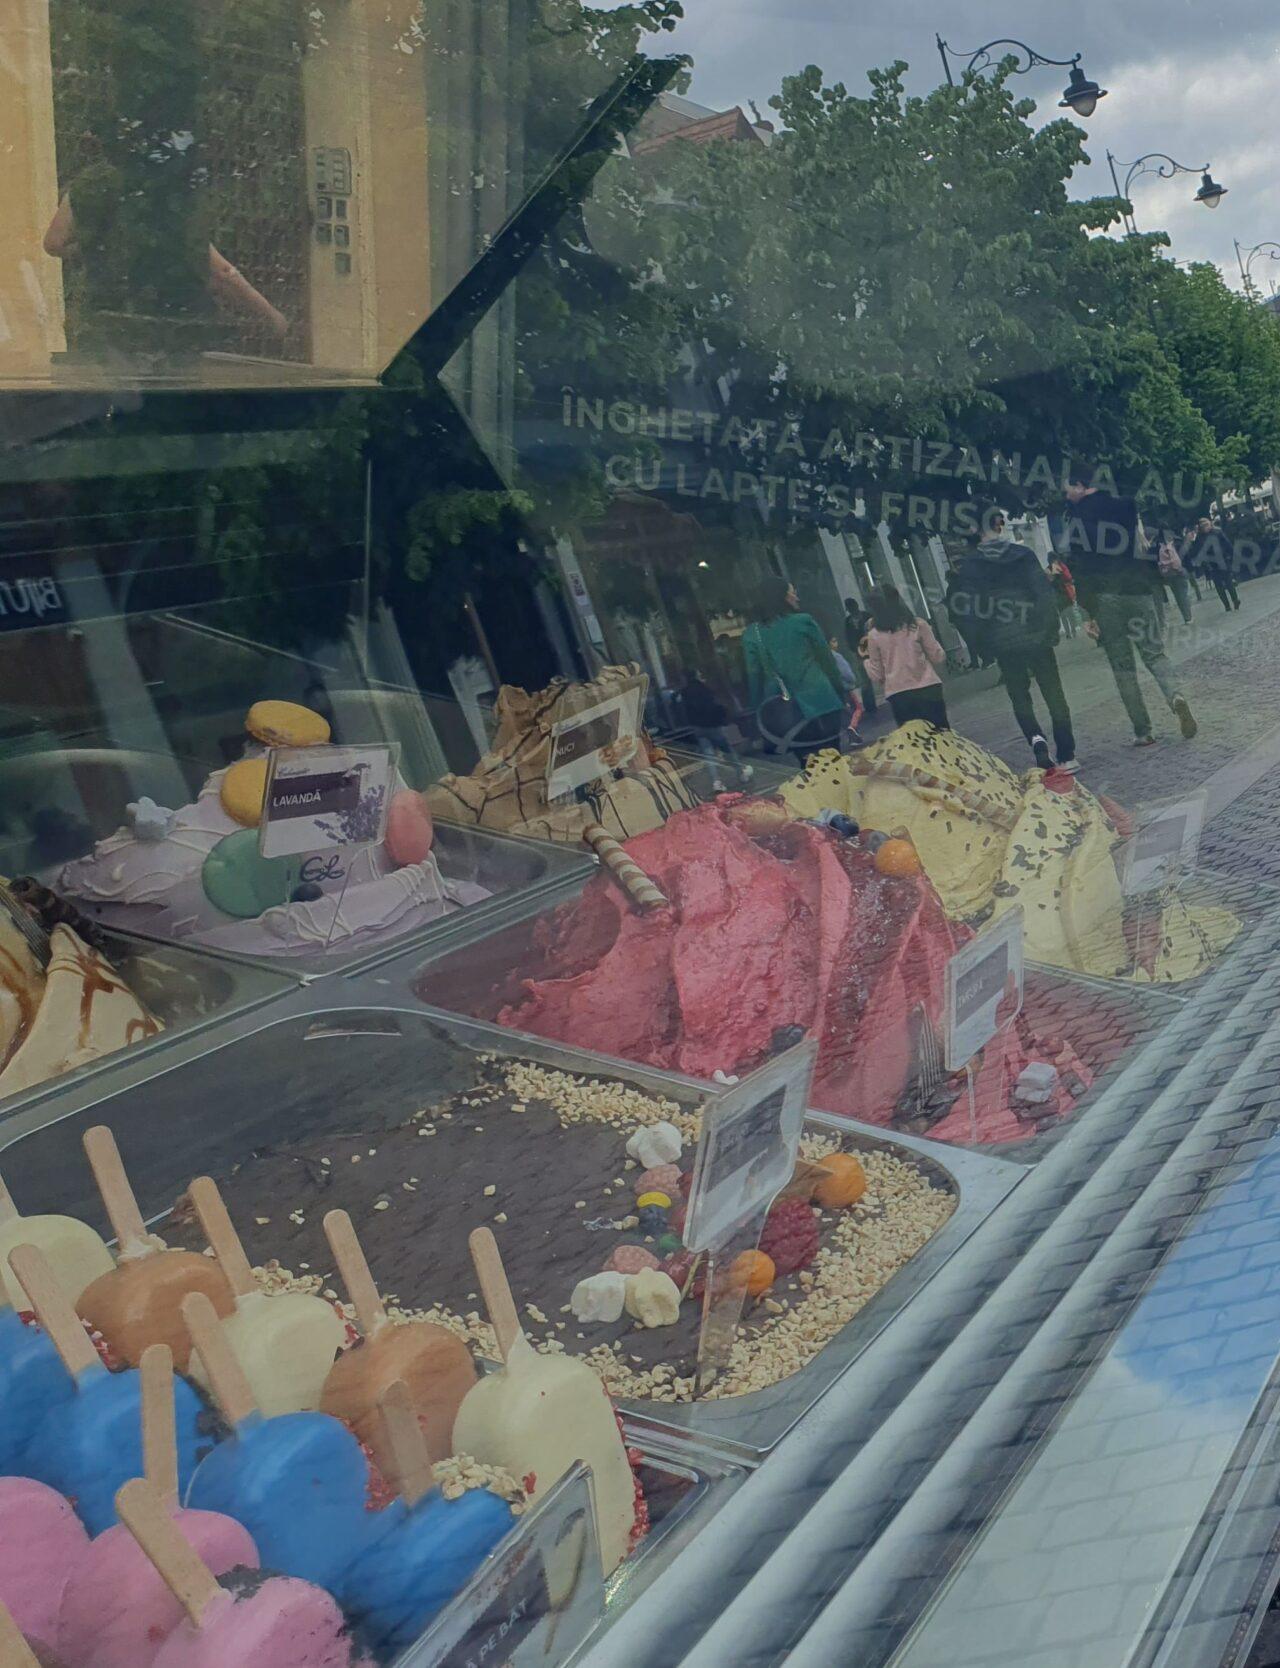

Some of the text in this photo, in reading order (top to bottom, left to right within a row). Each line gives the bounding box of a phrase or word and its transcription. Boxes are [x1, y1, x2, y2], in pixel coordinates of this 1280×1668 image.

[604, 454, 661, 490] CU
[676, 463, 811, 514] LAPTE
[950, 591, 1034, 625] GUST
